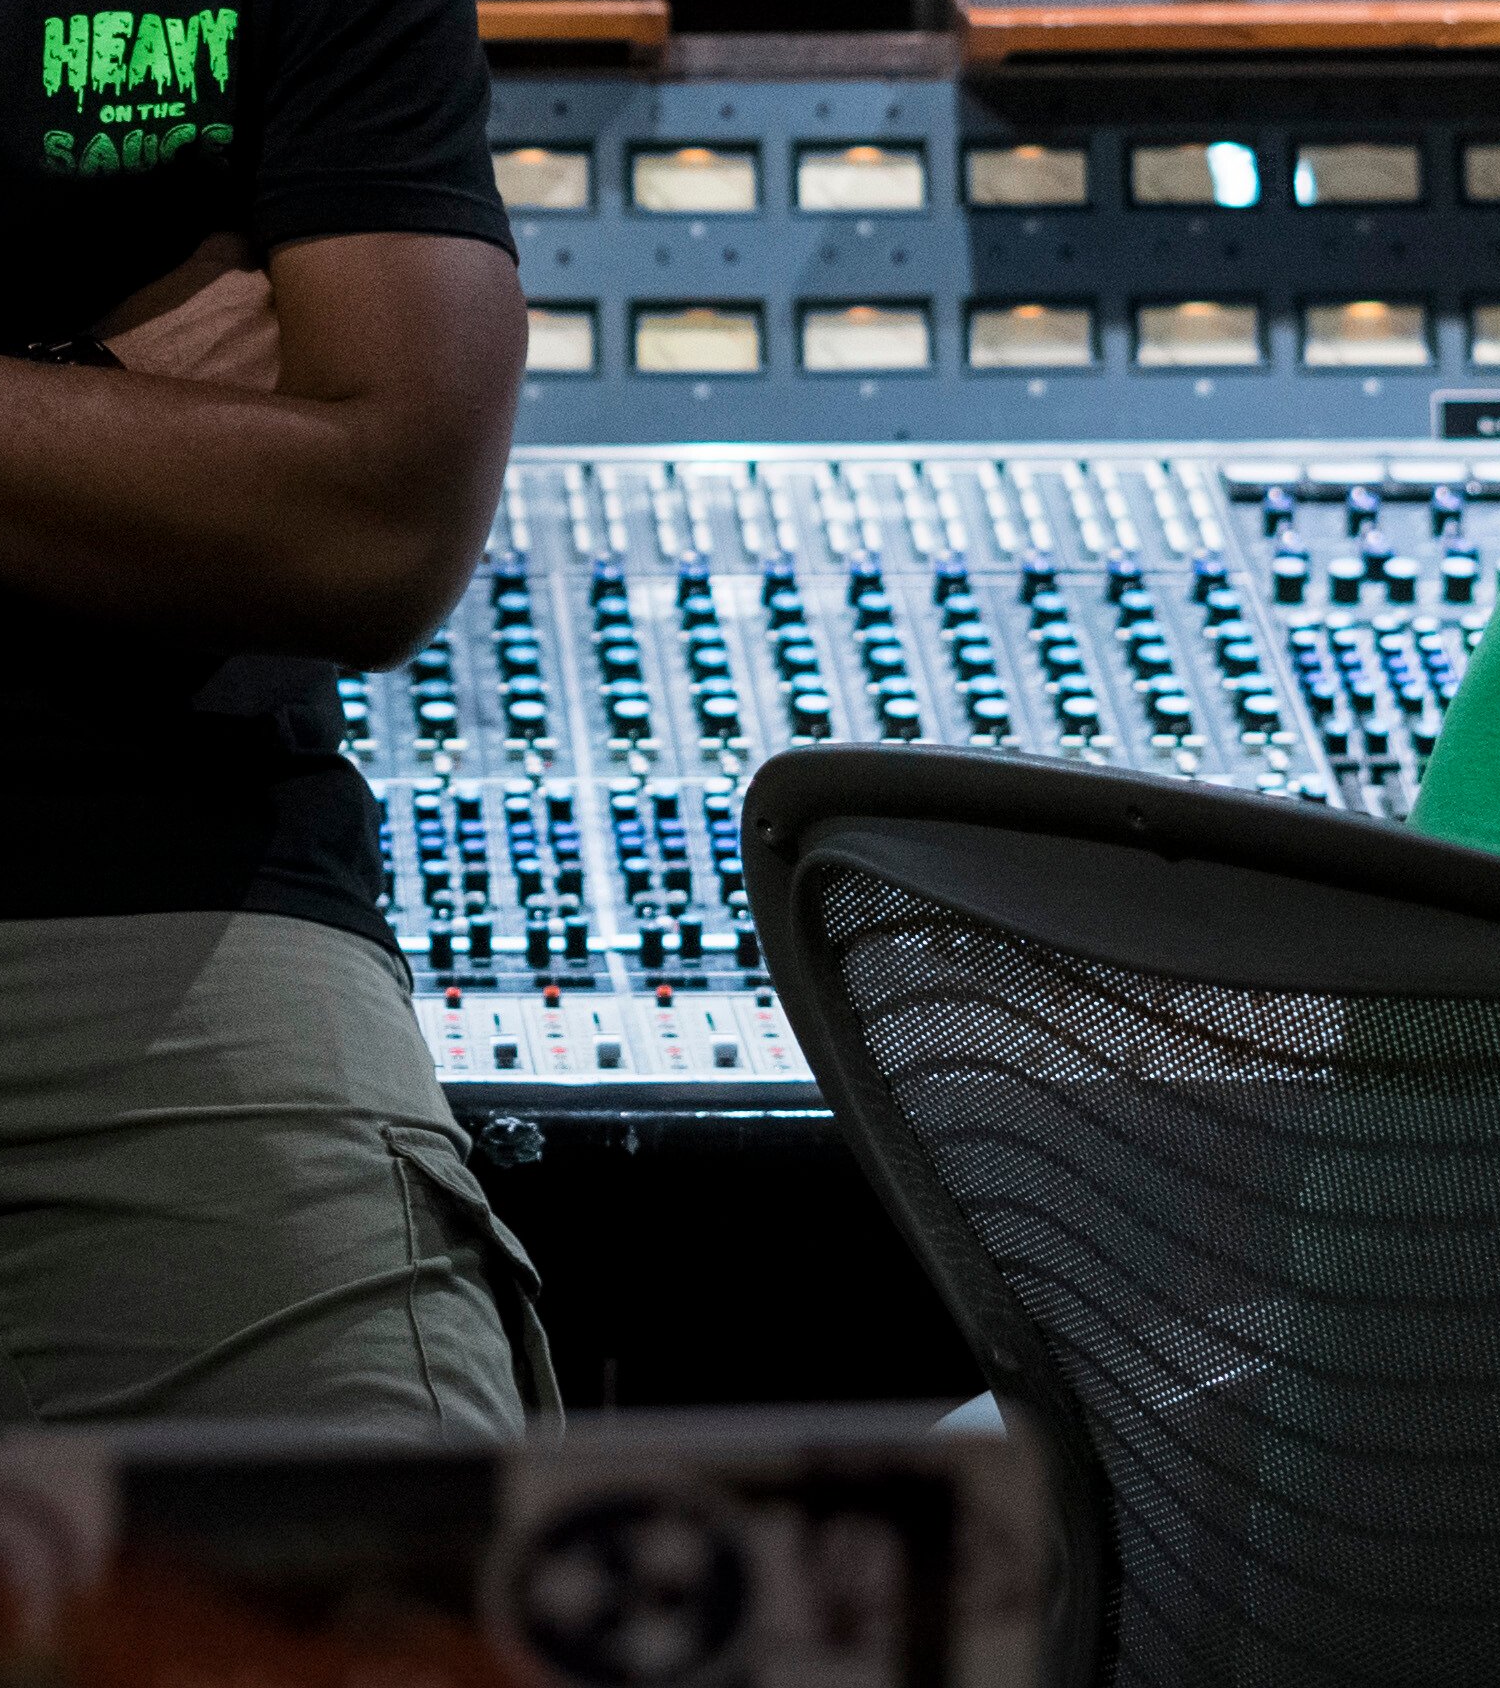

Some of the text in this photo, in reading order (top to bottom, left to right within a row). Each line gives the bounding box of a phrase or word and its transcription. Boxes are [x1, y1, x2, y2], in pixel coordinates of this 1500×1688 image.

[42, 8, 239, 113] HEAVY
[99, 102, 187, 123] ON THE
